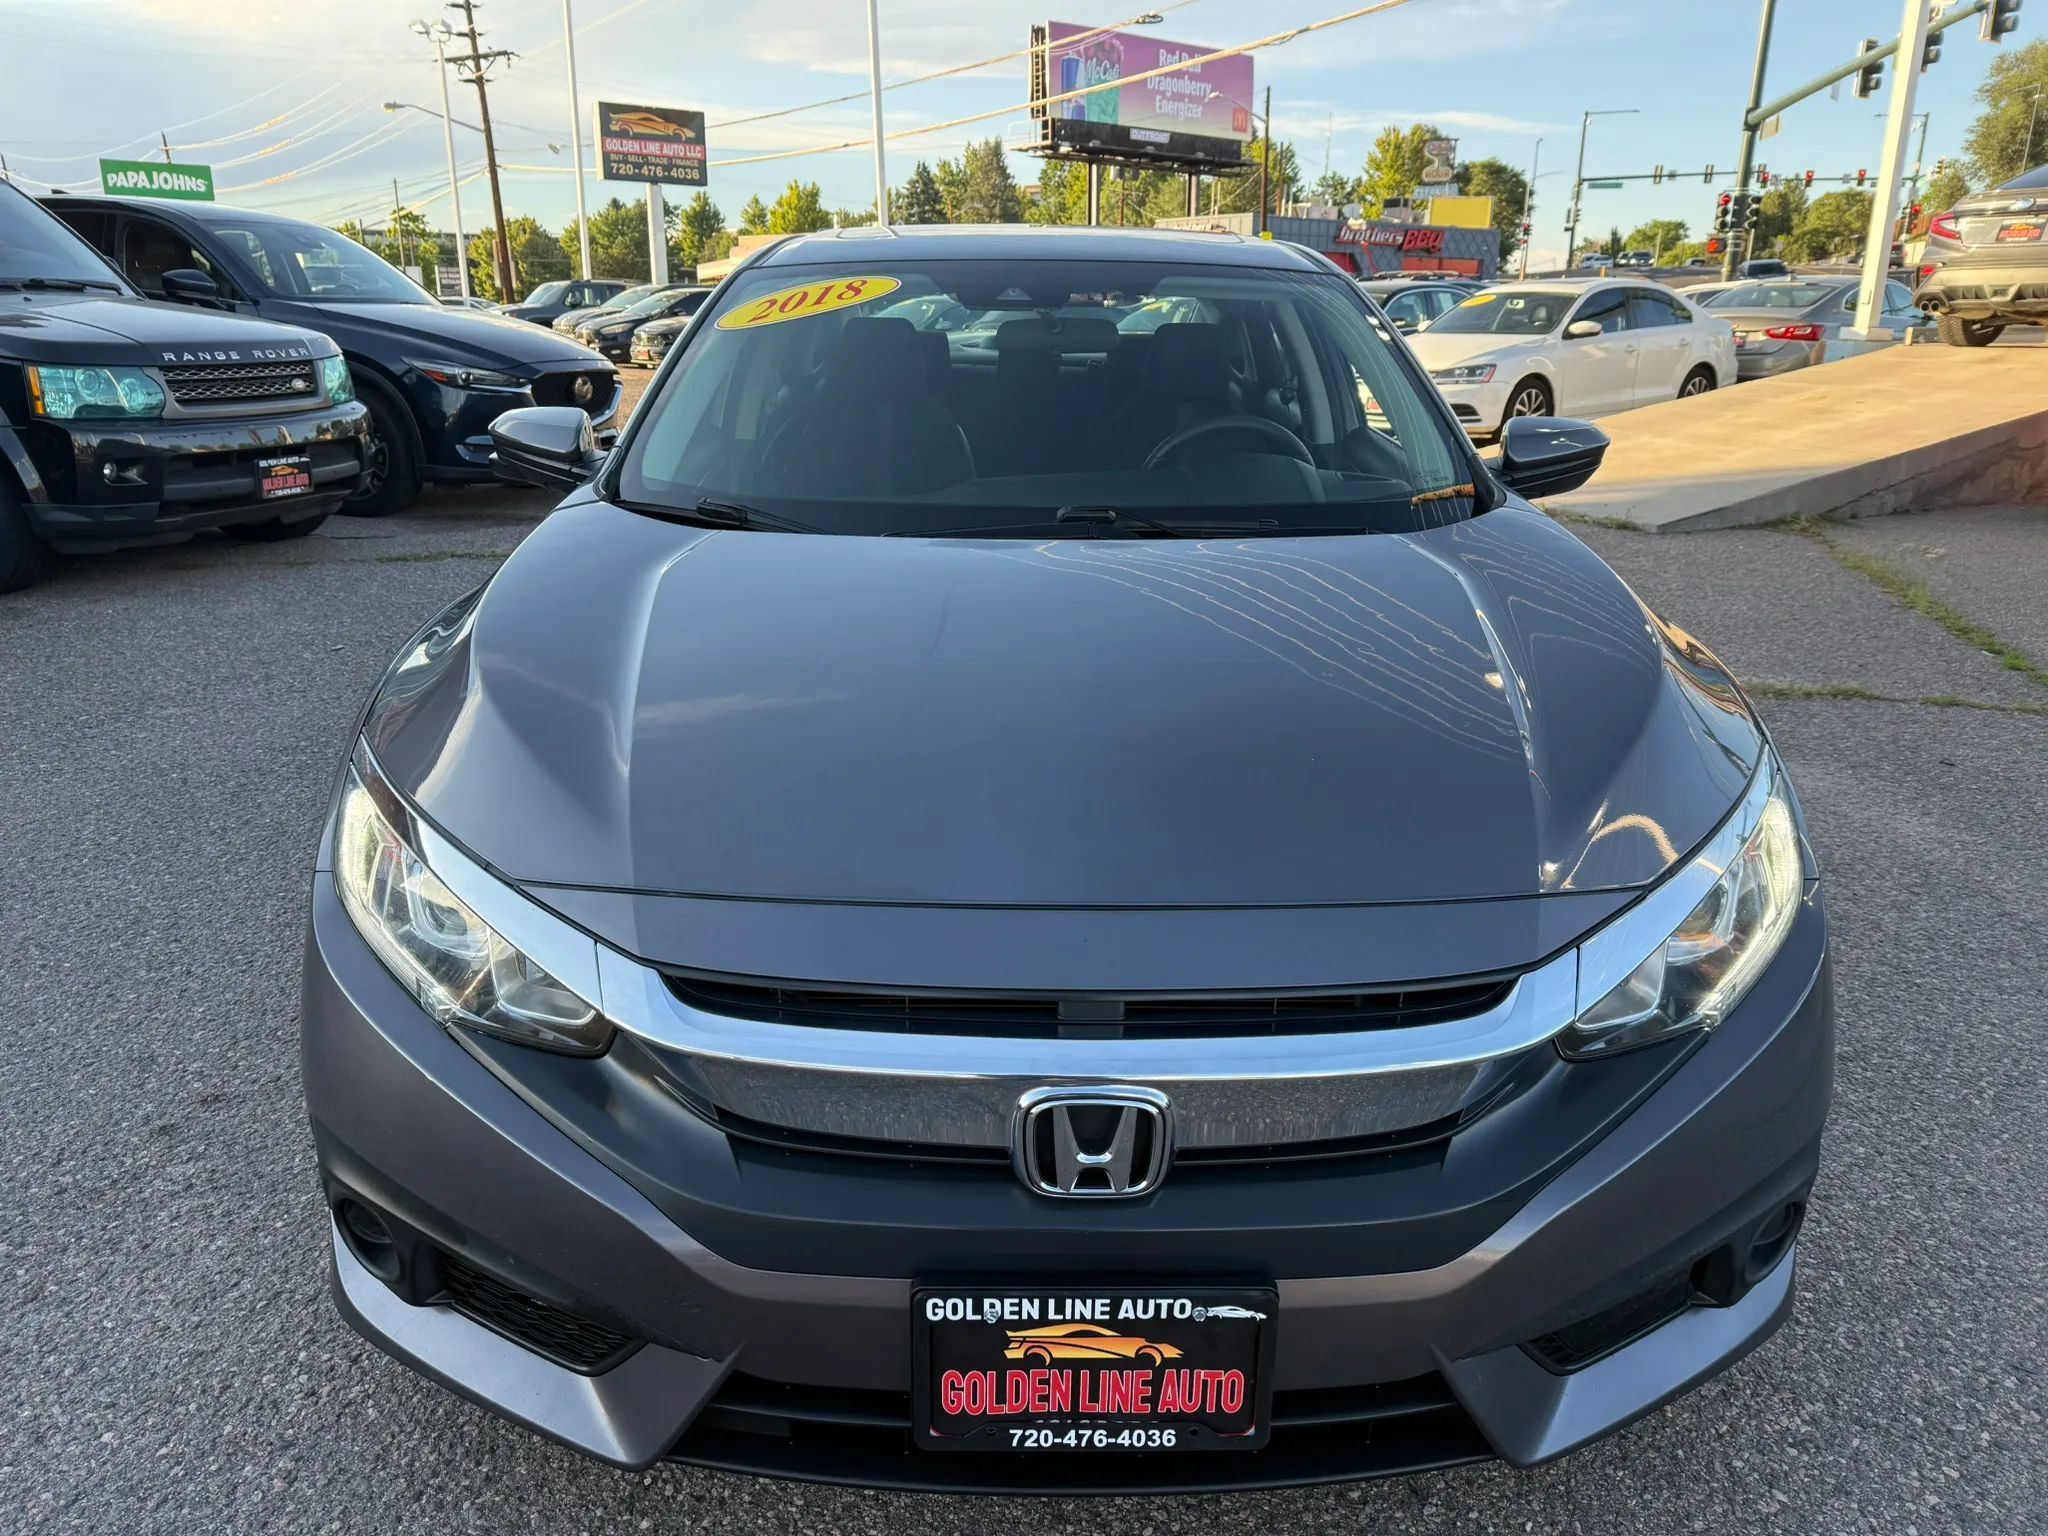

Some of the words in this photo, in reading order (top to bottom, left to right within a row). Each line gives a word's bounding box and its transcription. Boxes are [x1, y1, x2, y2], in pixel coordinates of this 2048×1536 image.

[1159, 48, 1180, 68] Red
[1147, 74, 1212, 103] Dragonberry
[1155, 95, 1203, 121] Energizer
[606, 138, 640, 151] GOLDEN
[641, 141, 661, 153] LINE
[662, 143, 685, 156] AUTO
[686, 145, 702, 156] LLC
[610, 153, 624, 161] BUY
[627, 154, 643, 163] SELL
[647, 156, 668, 165] TRADE
[106, 170, 151, 190] PAPA
[1403, 229, 1444, 251] BBQ
[746, 279, 868, 324] 2018
[162, 351, 241, 361] RANGE
[252, 348, 309, 359] ROVER
[926, 1297, 1039, 1321] GOLDEN
[1048, 1299, 1110, 1320] LINE
[1117, 1299, 1192, 1321] AUTO
[941, 1369, 1071, 1415] GOLDEN
[1079, 1369, 1152, 1413] LINE
[1157, 1369, 1245, 1413] AUTO
[1009, 1428, 1177, 1447] 720-476-4036
